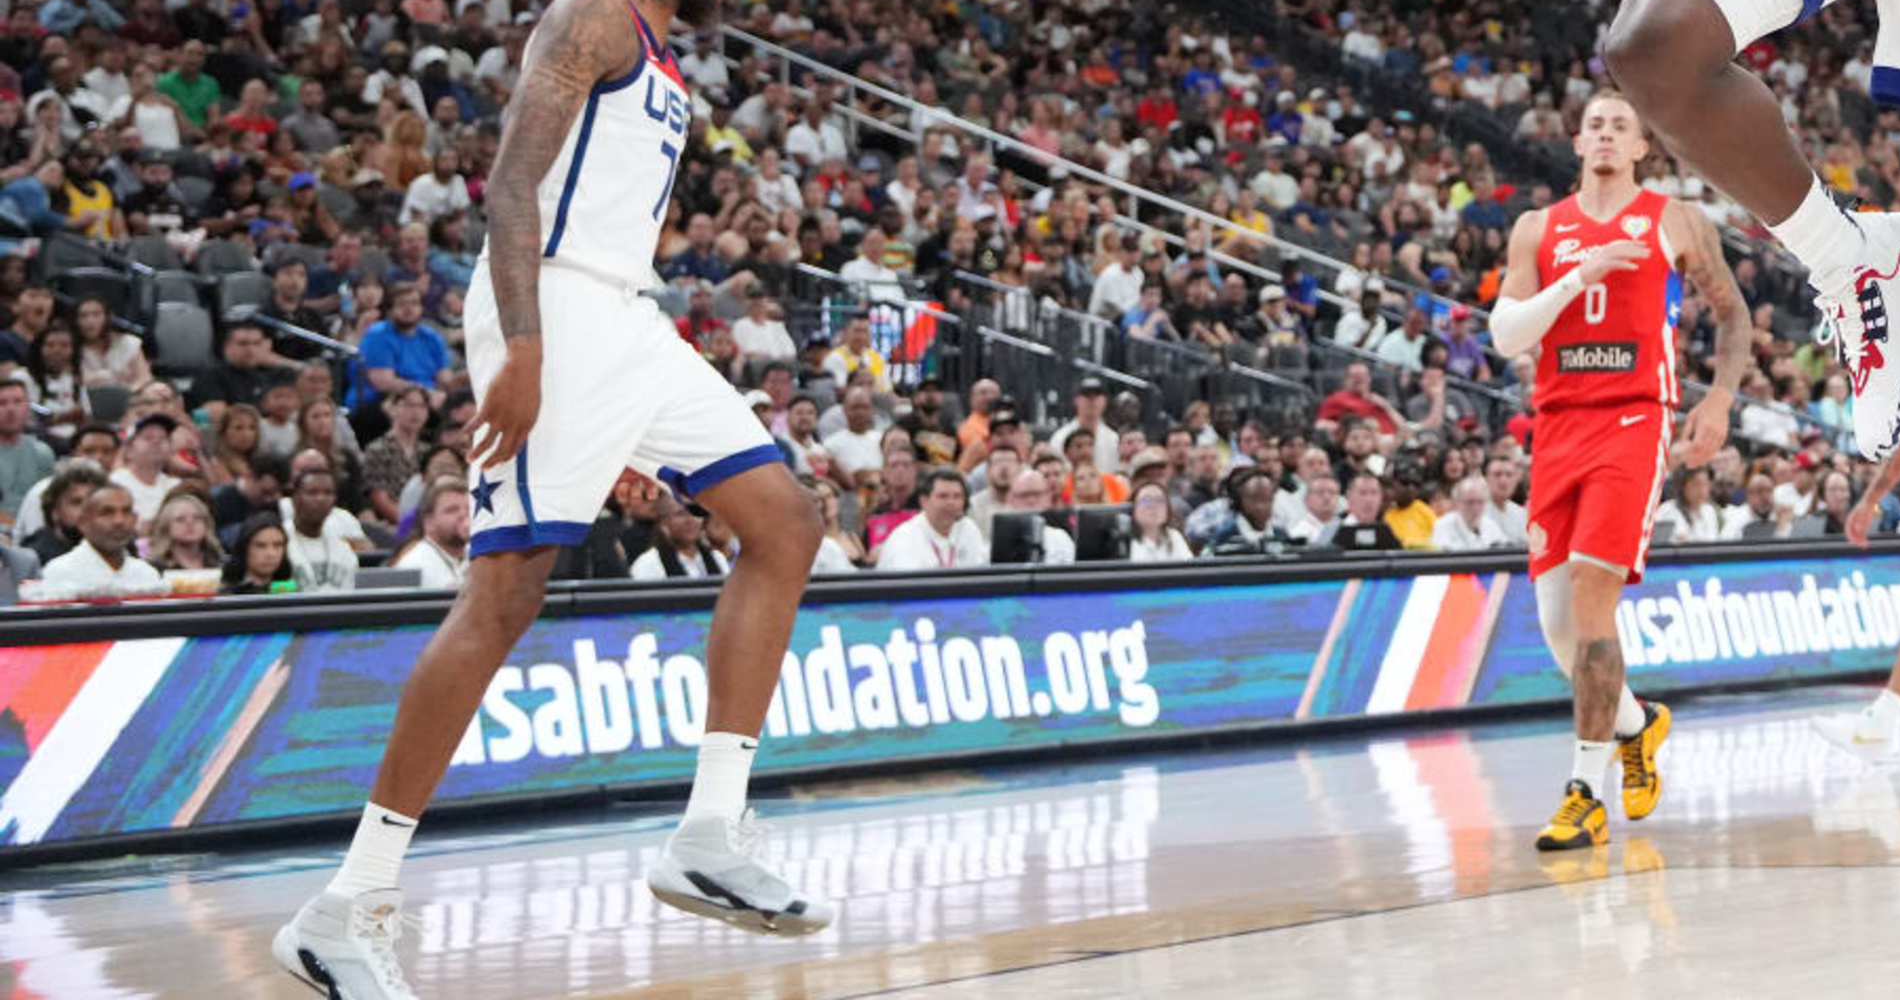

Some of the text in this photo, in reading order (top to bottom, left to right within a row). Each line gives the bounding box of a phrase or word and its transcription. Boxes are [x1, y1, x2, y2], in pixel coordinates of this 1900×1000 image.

[644, 74, 690, 135] US
[652, 139, 677, 221] 7
[1584, 282, 1607, 324] 0
[450, 617, 1160, 767] sabfondation.org
